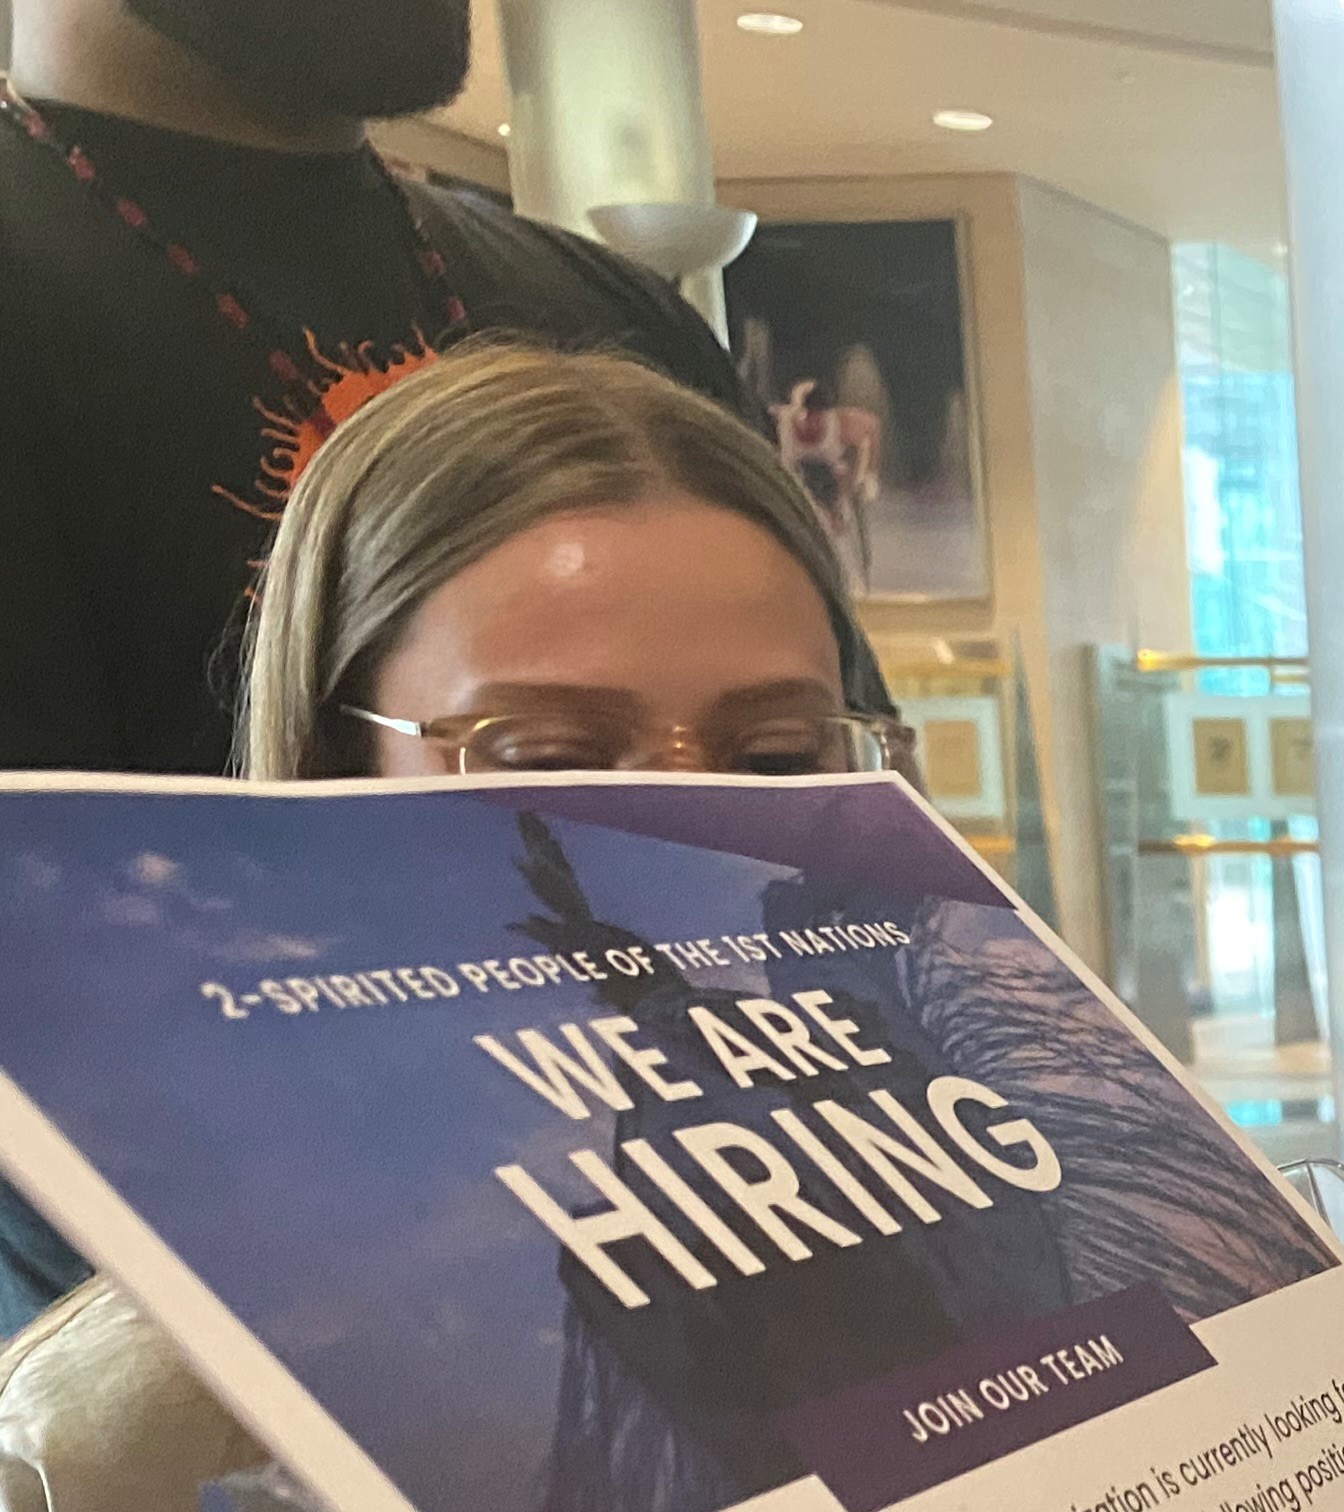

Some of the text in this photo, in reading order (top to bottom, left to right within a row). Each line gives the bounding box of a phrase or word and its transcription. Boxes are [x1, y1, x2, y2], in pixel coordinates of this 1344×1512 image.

[200, 921, 911, 1019] 2-SPIRITED PEOPLE OF THE 1ST NATIONS
[472, 989, 892, 1120] WE ARE
[494, 1075, 1062, 1310] HIRING
[901, 1335, 1124, 1443] JOIN OUR TEAM
[1156, 1464, 1182, 1496] is
[1179, 1409, 1273, 1488] currently
[1269, 1386, 1340, 1444] looking
